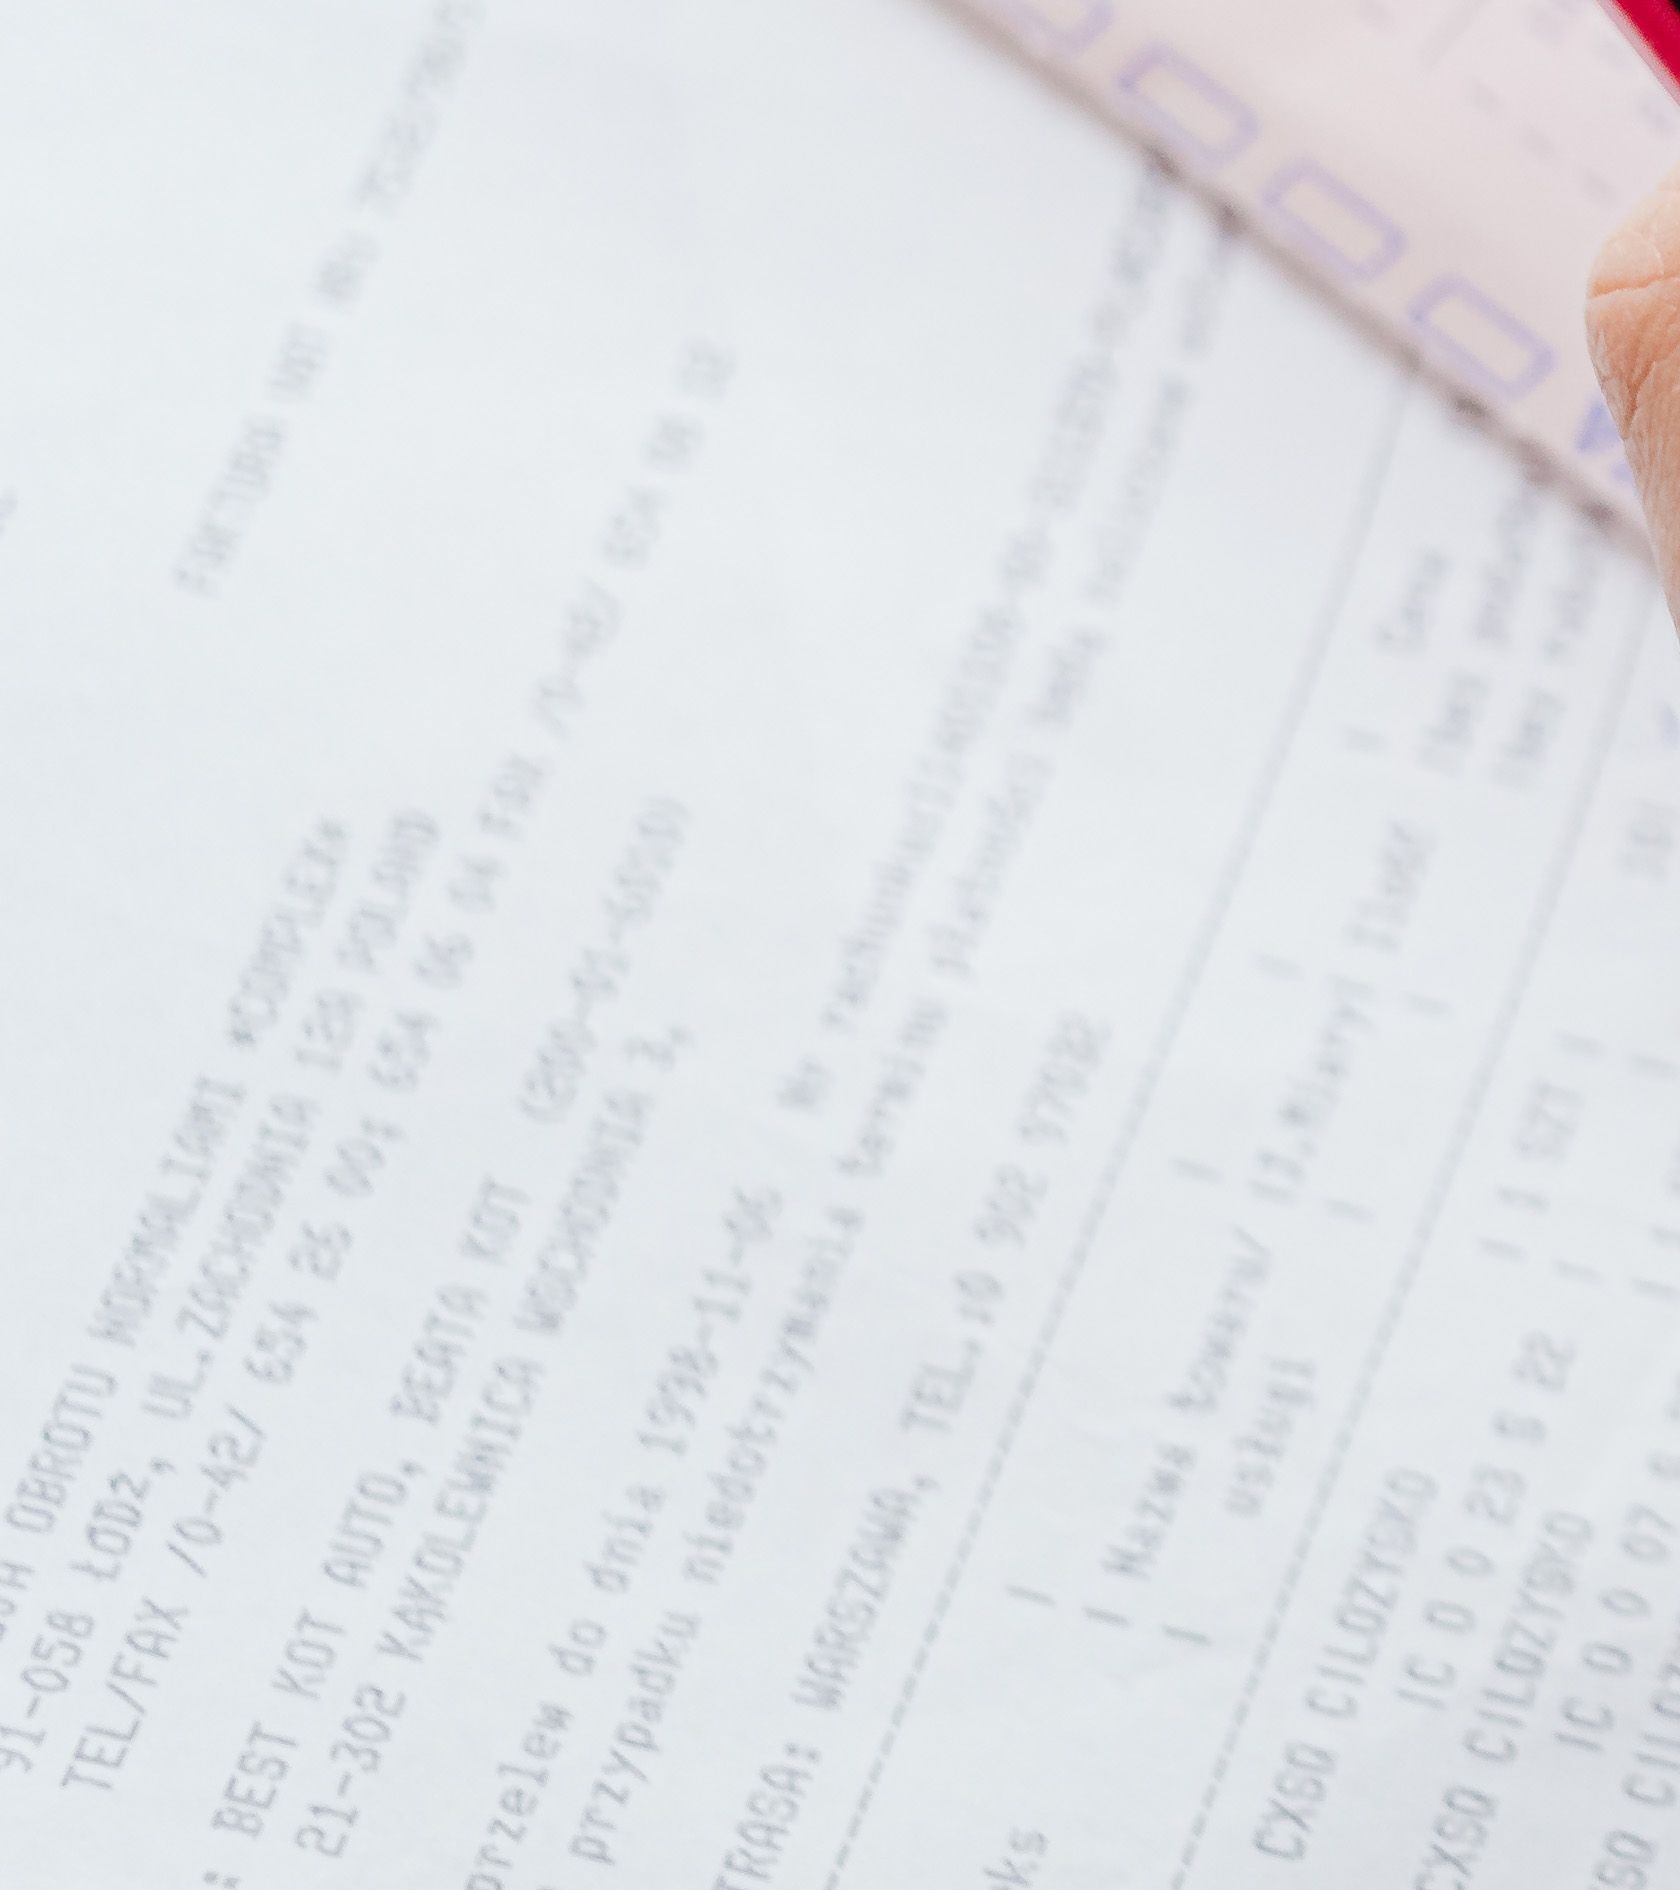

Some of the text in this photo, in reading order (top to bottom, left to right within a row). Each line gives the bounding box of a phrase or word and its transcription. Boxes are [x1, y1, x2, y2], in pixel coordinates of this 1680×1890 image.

[2, 1363, 120, 1536] OBROTU
[209, 1719, 300, 1840] BEST
[269, 1606, 348, 1703] KOT
[319, 1458, 427, 1591] AUTO,
[386, 1284, 489, 1428] BEATA
[457, 1173, 531, 1266] KOT
[546, 1618, 609, 1678] do
[582, 1484, 668, 1595] dnia
[789, 1473, 941, 1713] WARSZAWA,
[58, 1595, 190, 1793] TEL/FAX
[292, 1682, 408, 1860] 21-302
[567, 1610, 702, 1868] przypadku
